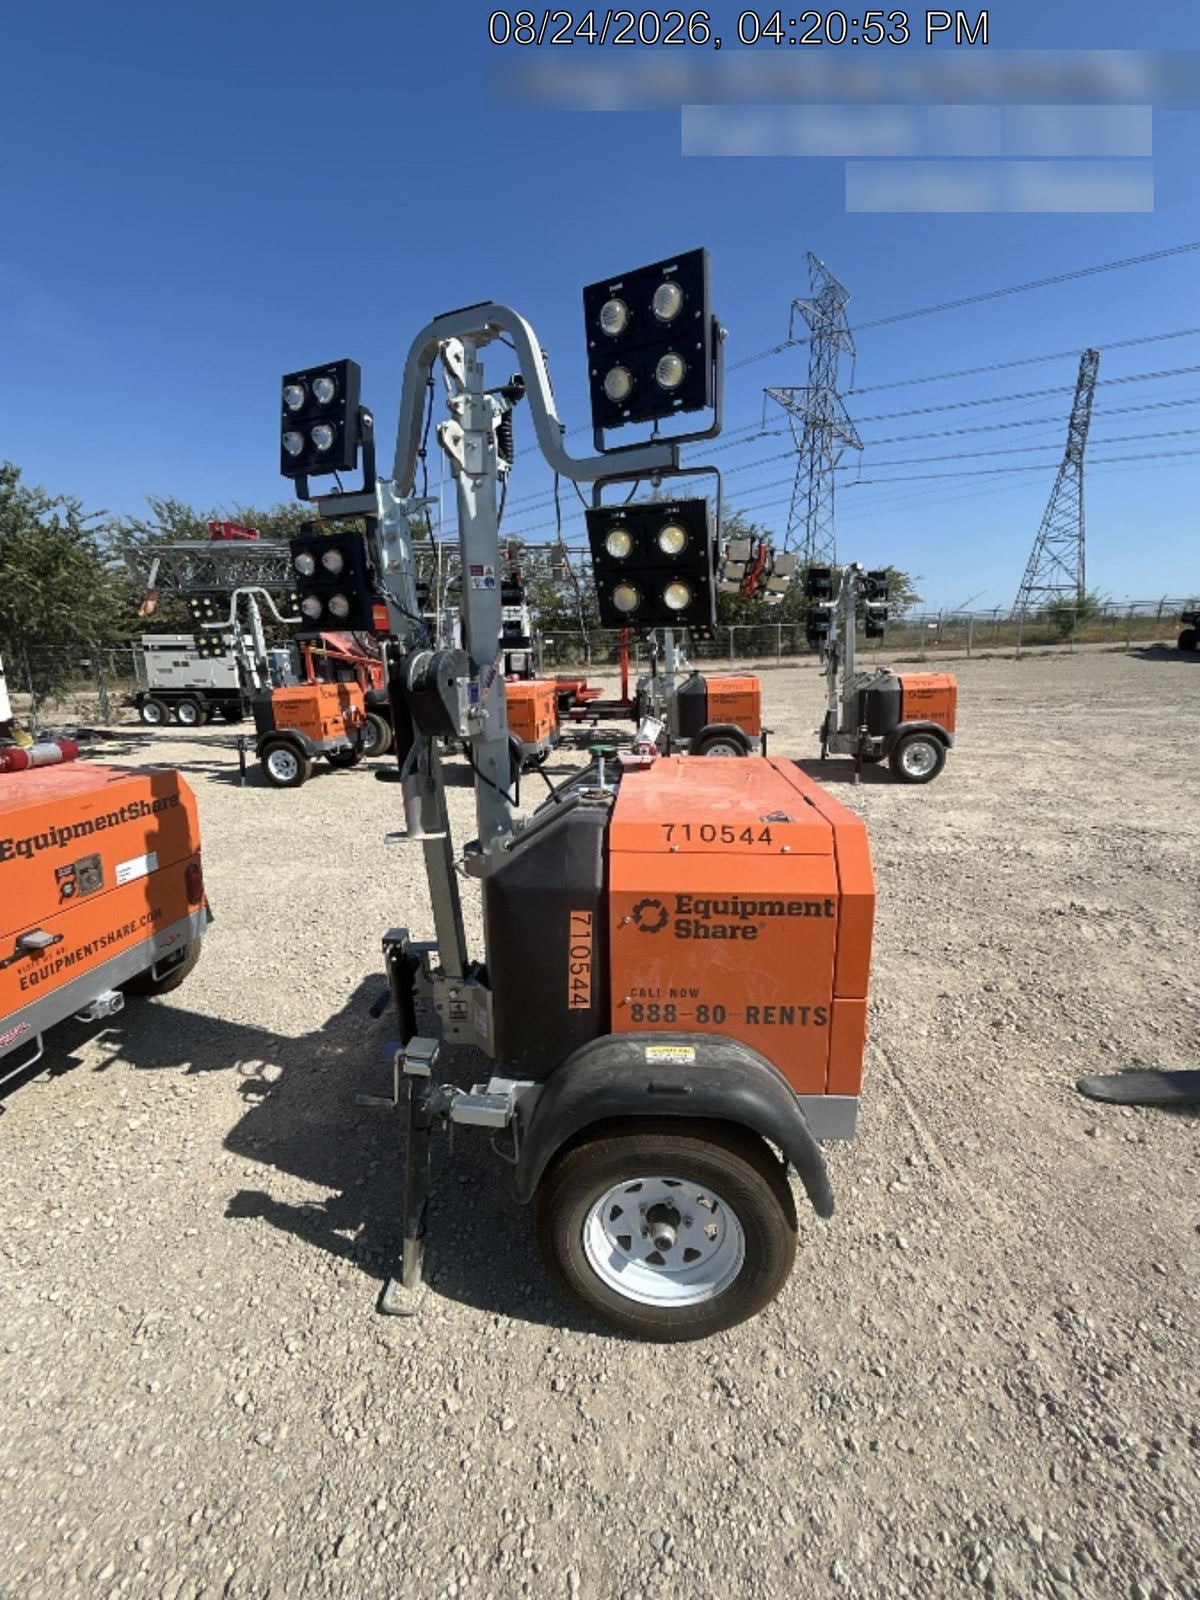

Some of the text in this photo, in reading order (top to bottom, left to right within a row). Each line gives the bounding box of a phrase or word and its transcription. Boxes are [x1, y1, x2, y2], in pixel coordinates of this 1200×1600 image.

[0, 794, 180, 862] EquipmentShare
[661, 823, 773, 845] 710544
[674, 895, 835, 920] Equipment
[20, 908, 163, 991] EQUIPMENTSHARE.COM
[569, 913, 592, 1007] 710544
[630, 987, 700, 999] CALL NOW
